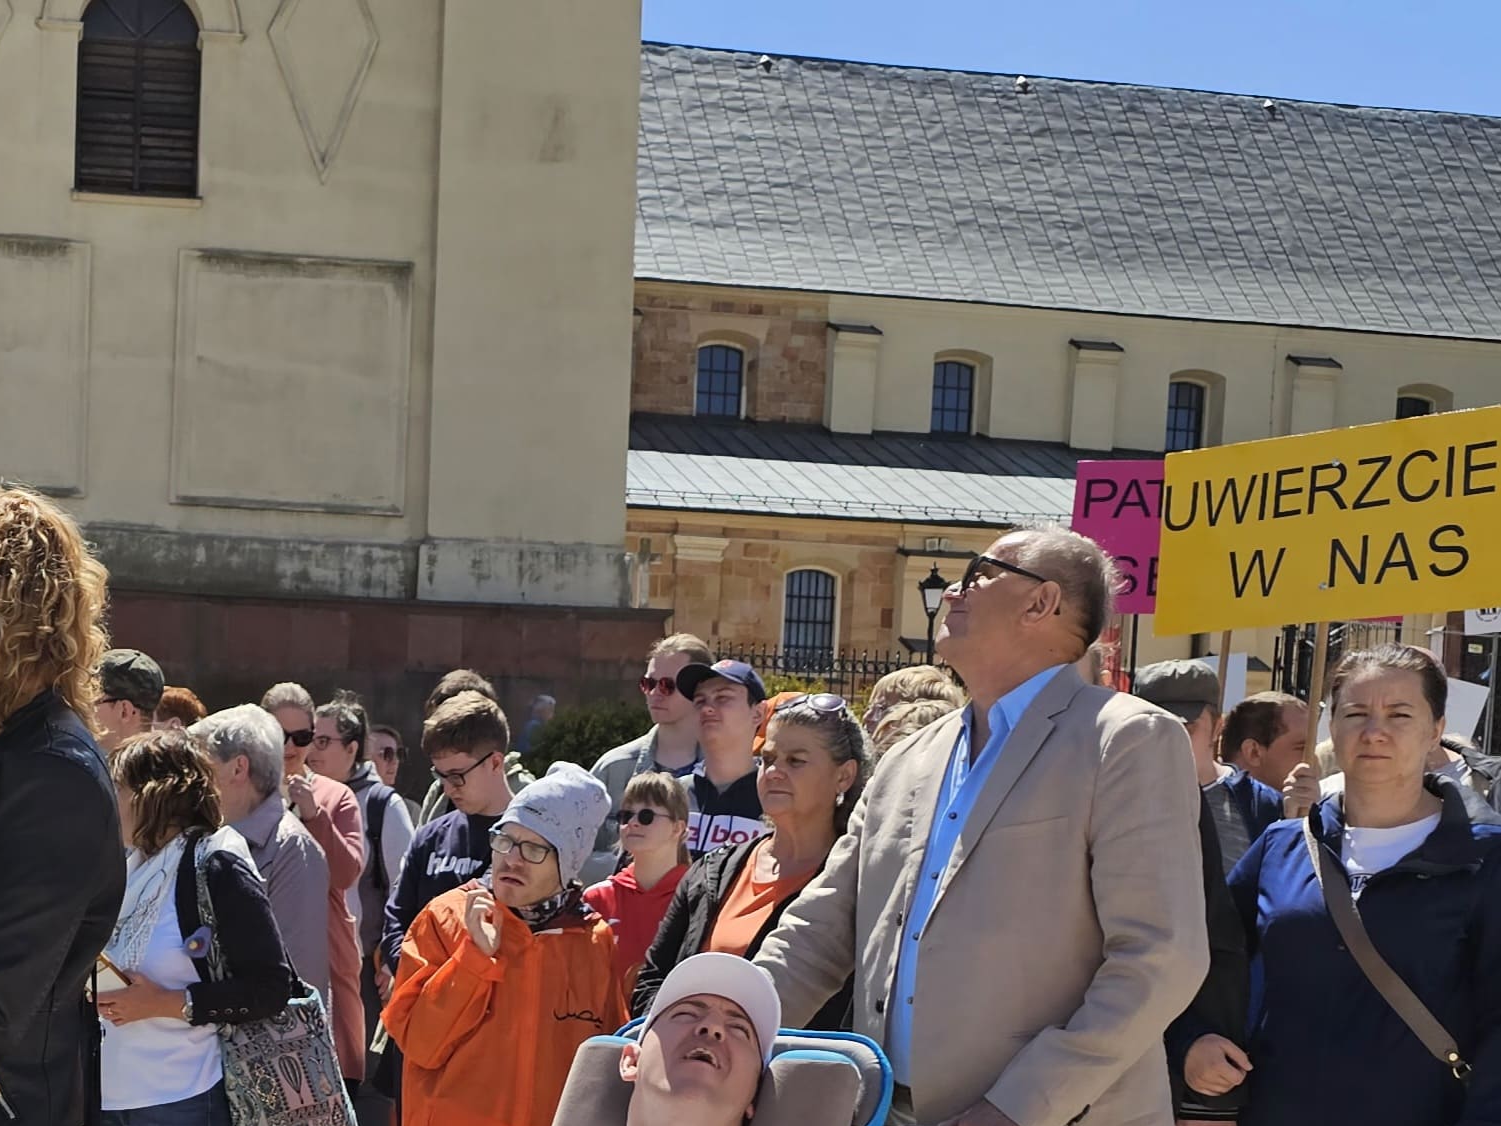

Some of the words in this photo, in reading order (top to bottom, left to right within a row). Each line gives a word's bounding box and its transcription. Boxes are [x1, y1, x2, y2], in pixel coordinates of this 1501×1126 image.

[1164, 441, 1497, 532] UWIERZCIE
[1229, 547, 1286, 598] W
[1328, 524, 1469, 588] NAS
